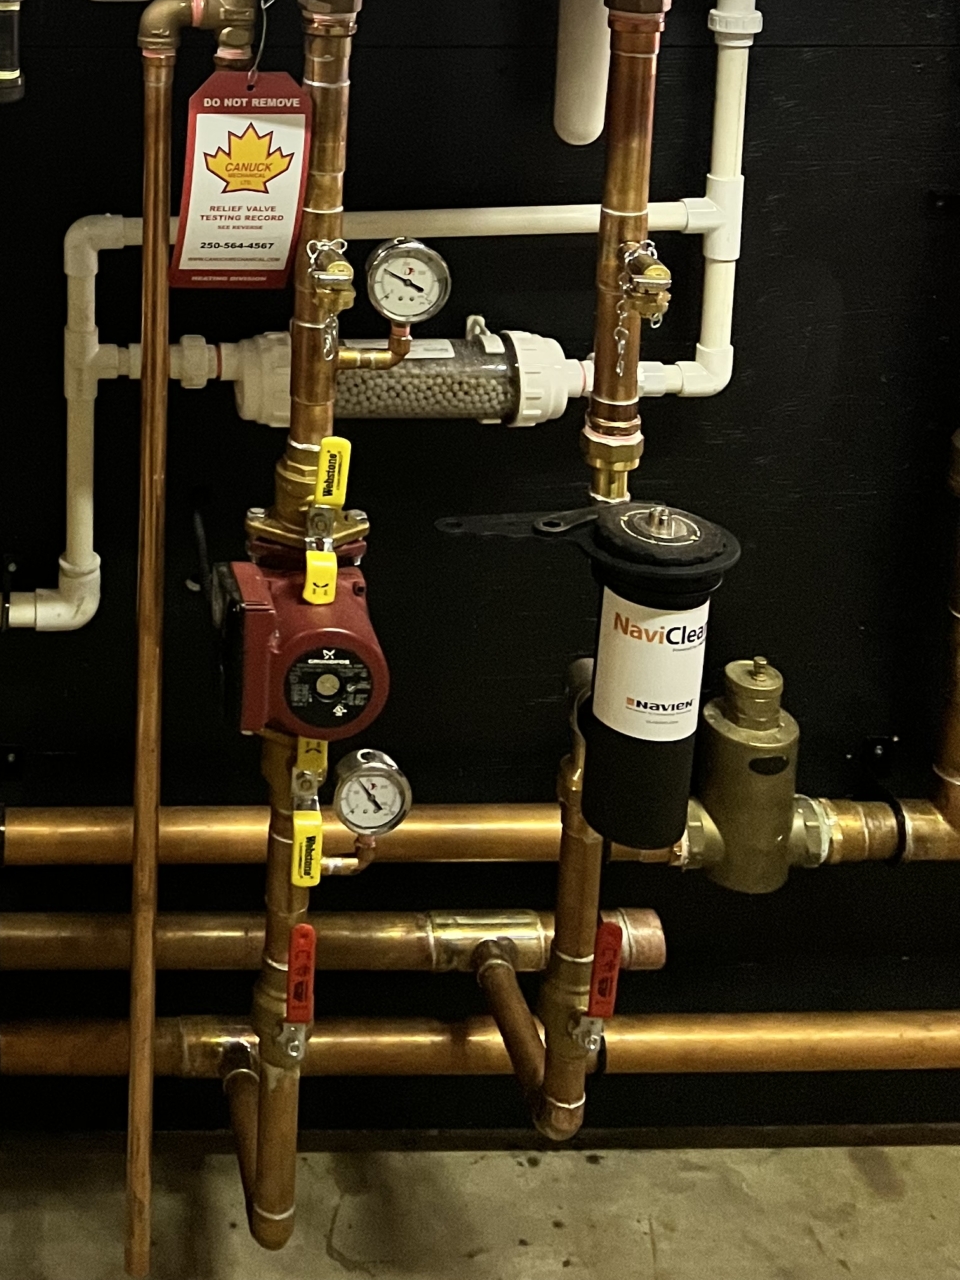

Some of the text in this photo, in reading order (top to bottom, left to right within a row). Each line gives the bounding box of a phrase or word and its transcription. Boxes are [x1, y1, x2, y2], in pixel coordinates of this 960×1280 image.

[203, 97, 301, 108] DO NOT REMOVE
[224, 162, 274, 173] CANUCK
[209, 205, 277, 213] RELIEF VALVE
[199, 214, 285, 222] TESTING RECORD
[199, 241, 275, 250] 250-564-4567
[322, 452, 338, 498] Webstone
